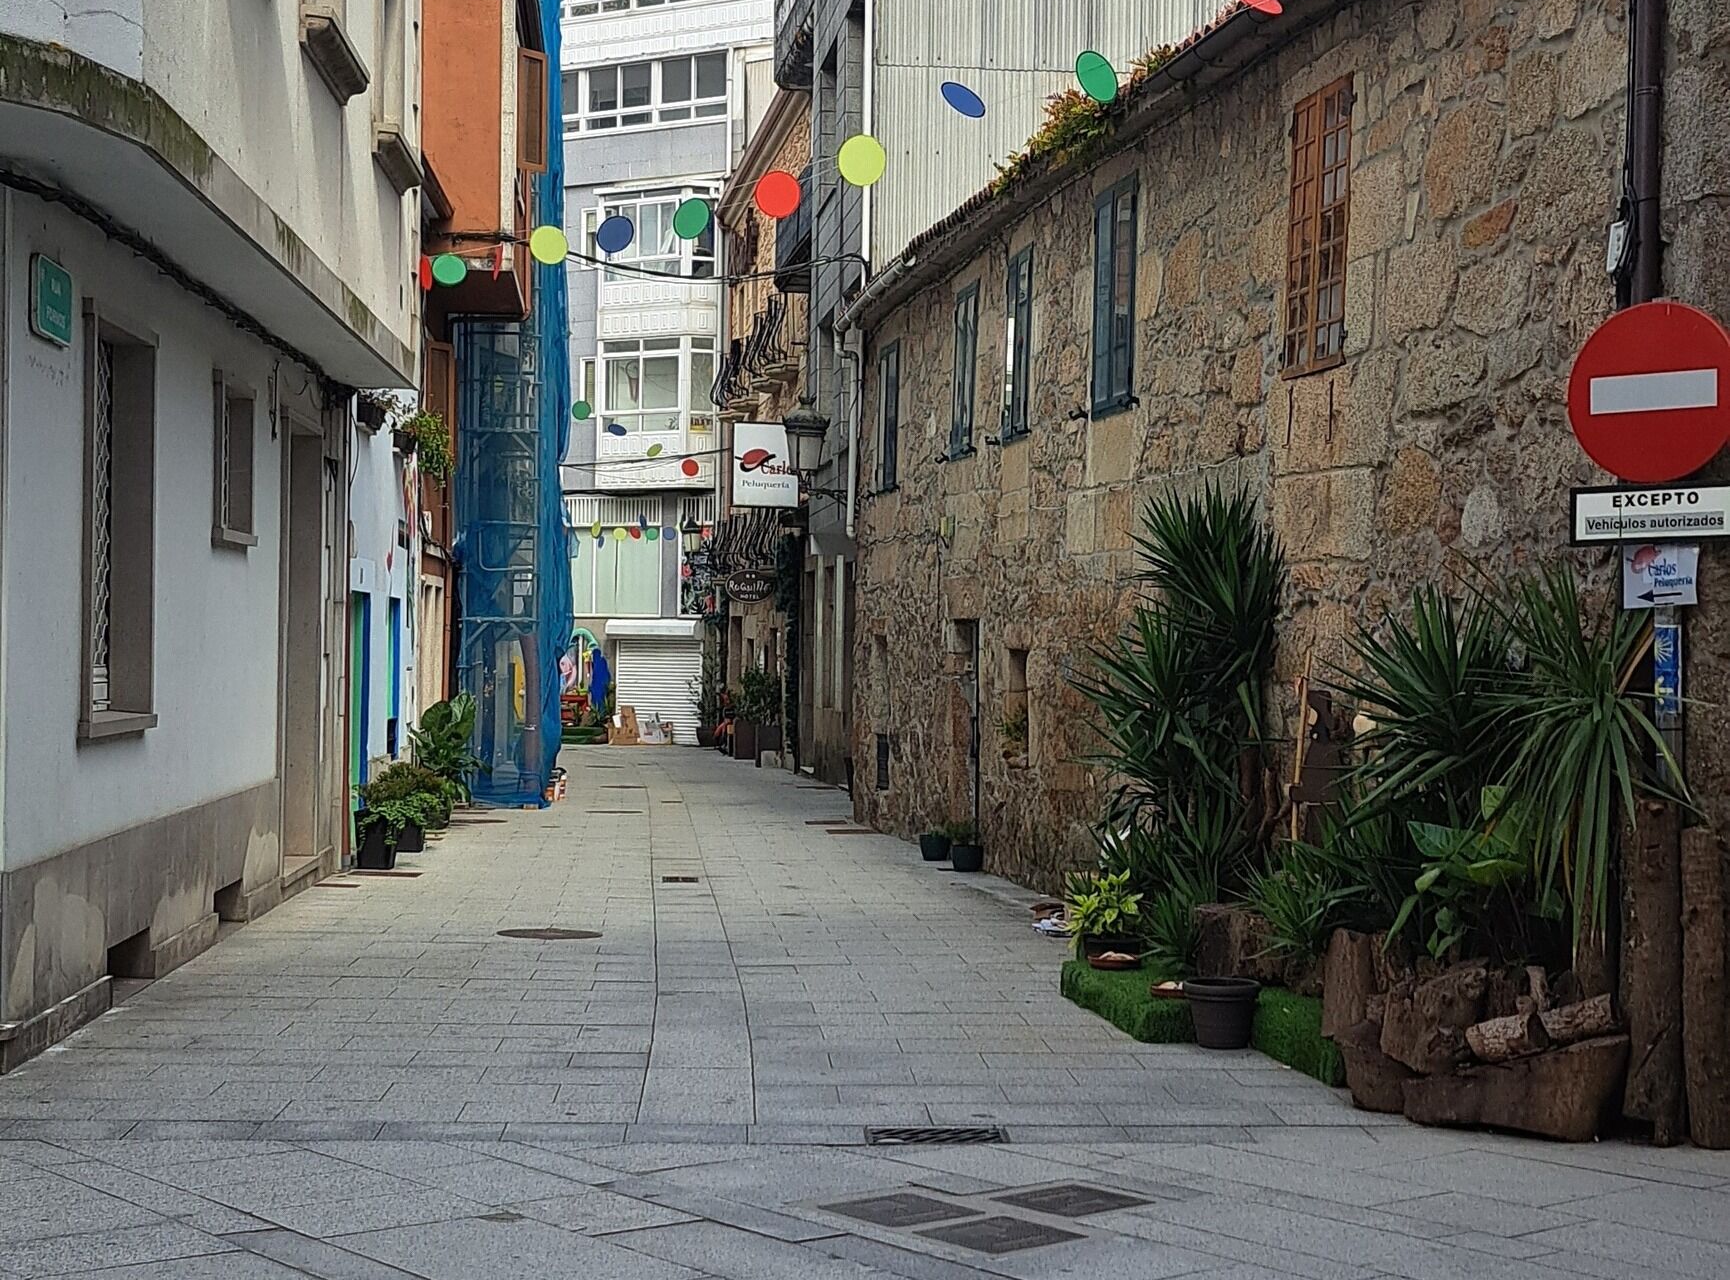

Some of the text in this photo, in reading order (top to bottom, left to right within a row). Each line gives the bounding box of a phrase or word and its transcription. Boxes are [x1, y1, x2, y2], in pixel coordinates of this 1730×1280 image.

[742, 479, 790, 490] Peluquería
[1612, 491, 1699, 508] EXCEPTO
[1587, 514, 1724, 531] Vehículos autorizados
